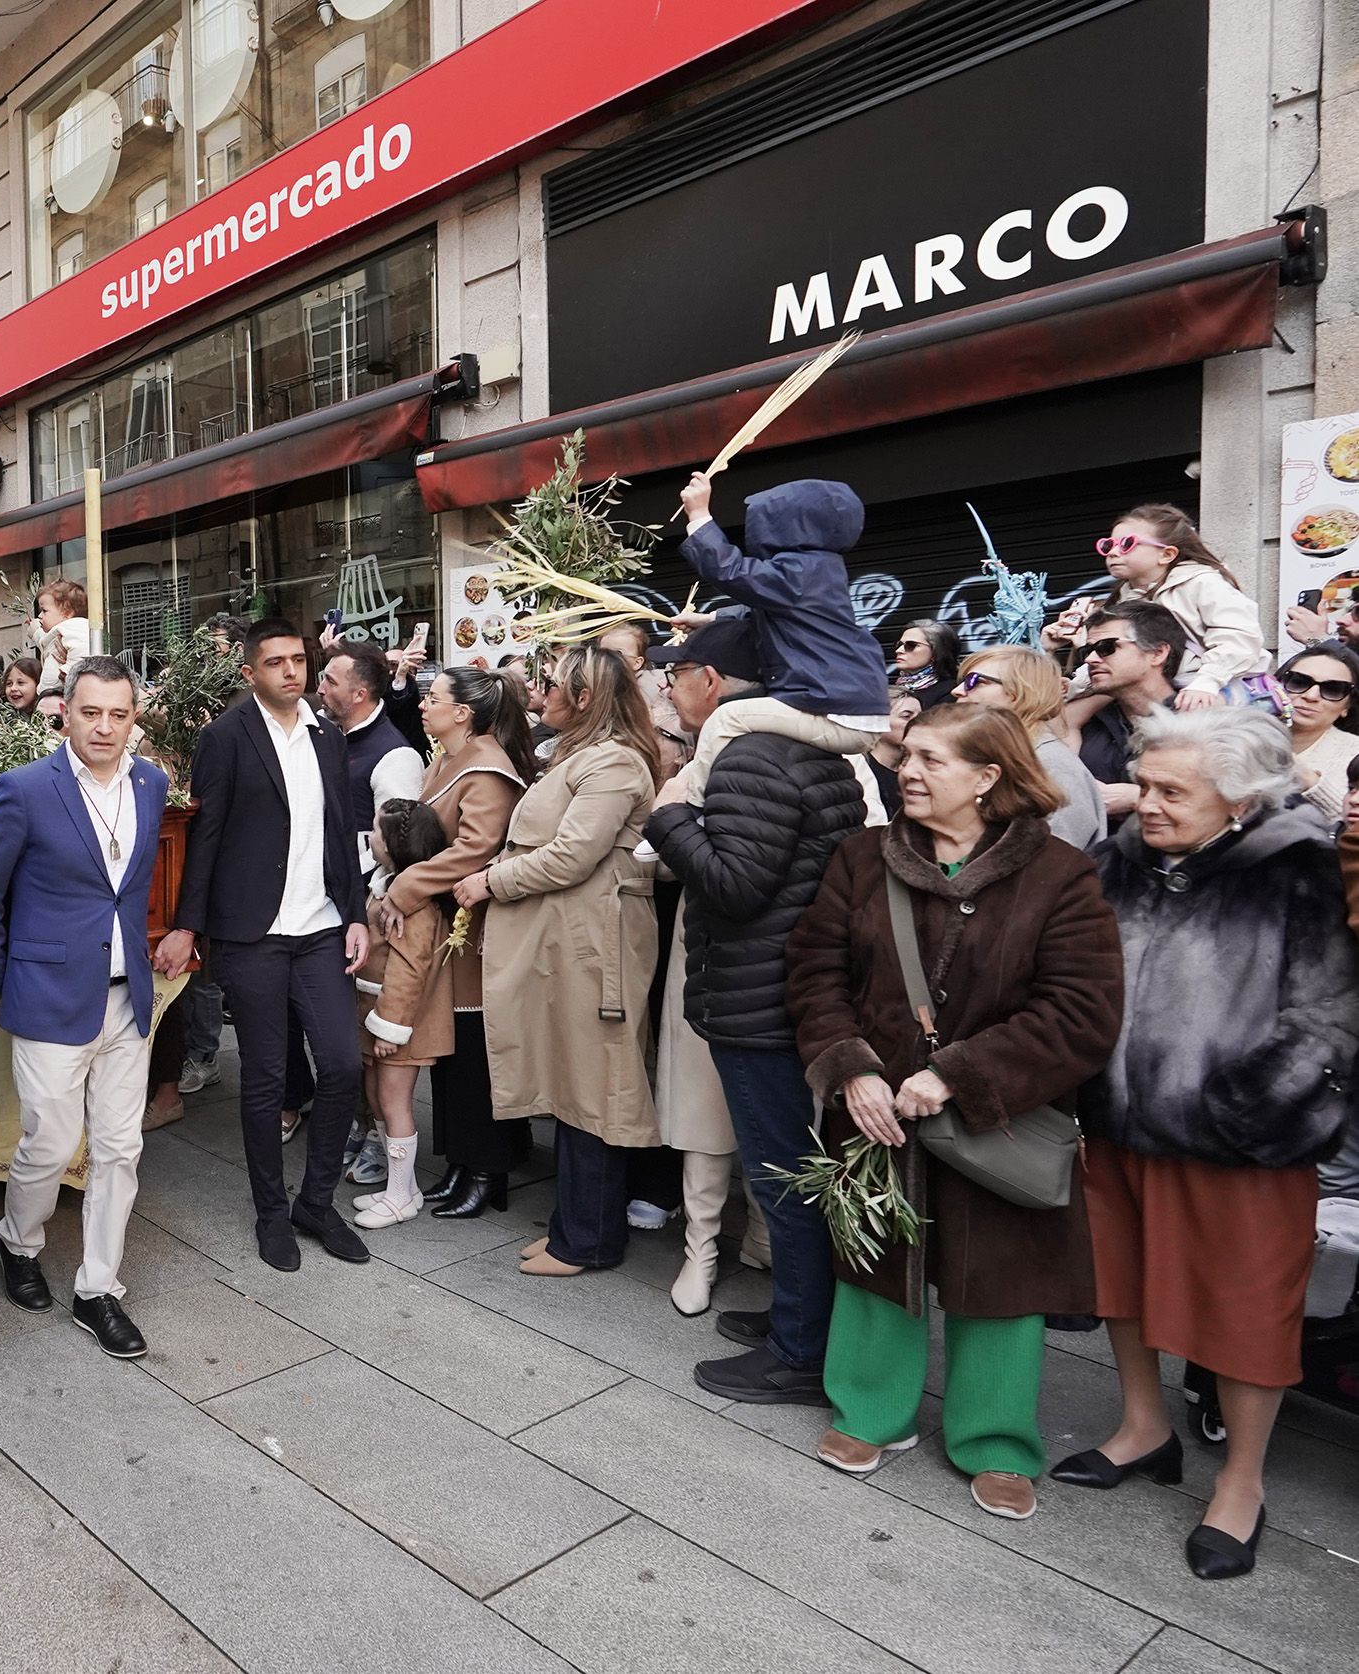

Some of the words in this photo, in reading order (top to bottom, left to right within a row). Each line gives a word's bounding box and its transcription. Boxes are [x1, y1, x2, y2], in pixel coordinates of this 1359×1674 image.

[101, 122, 412, 319] supermercado
[769, 185, 1129, 344] MARCO
[1340, 489, 1359, 497] TOST
[1310, 561, 1336, 569] BOWLS
